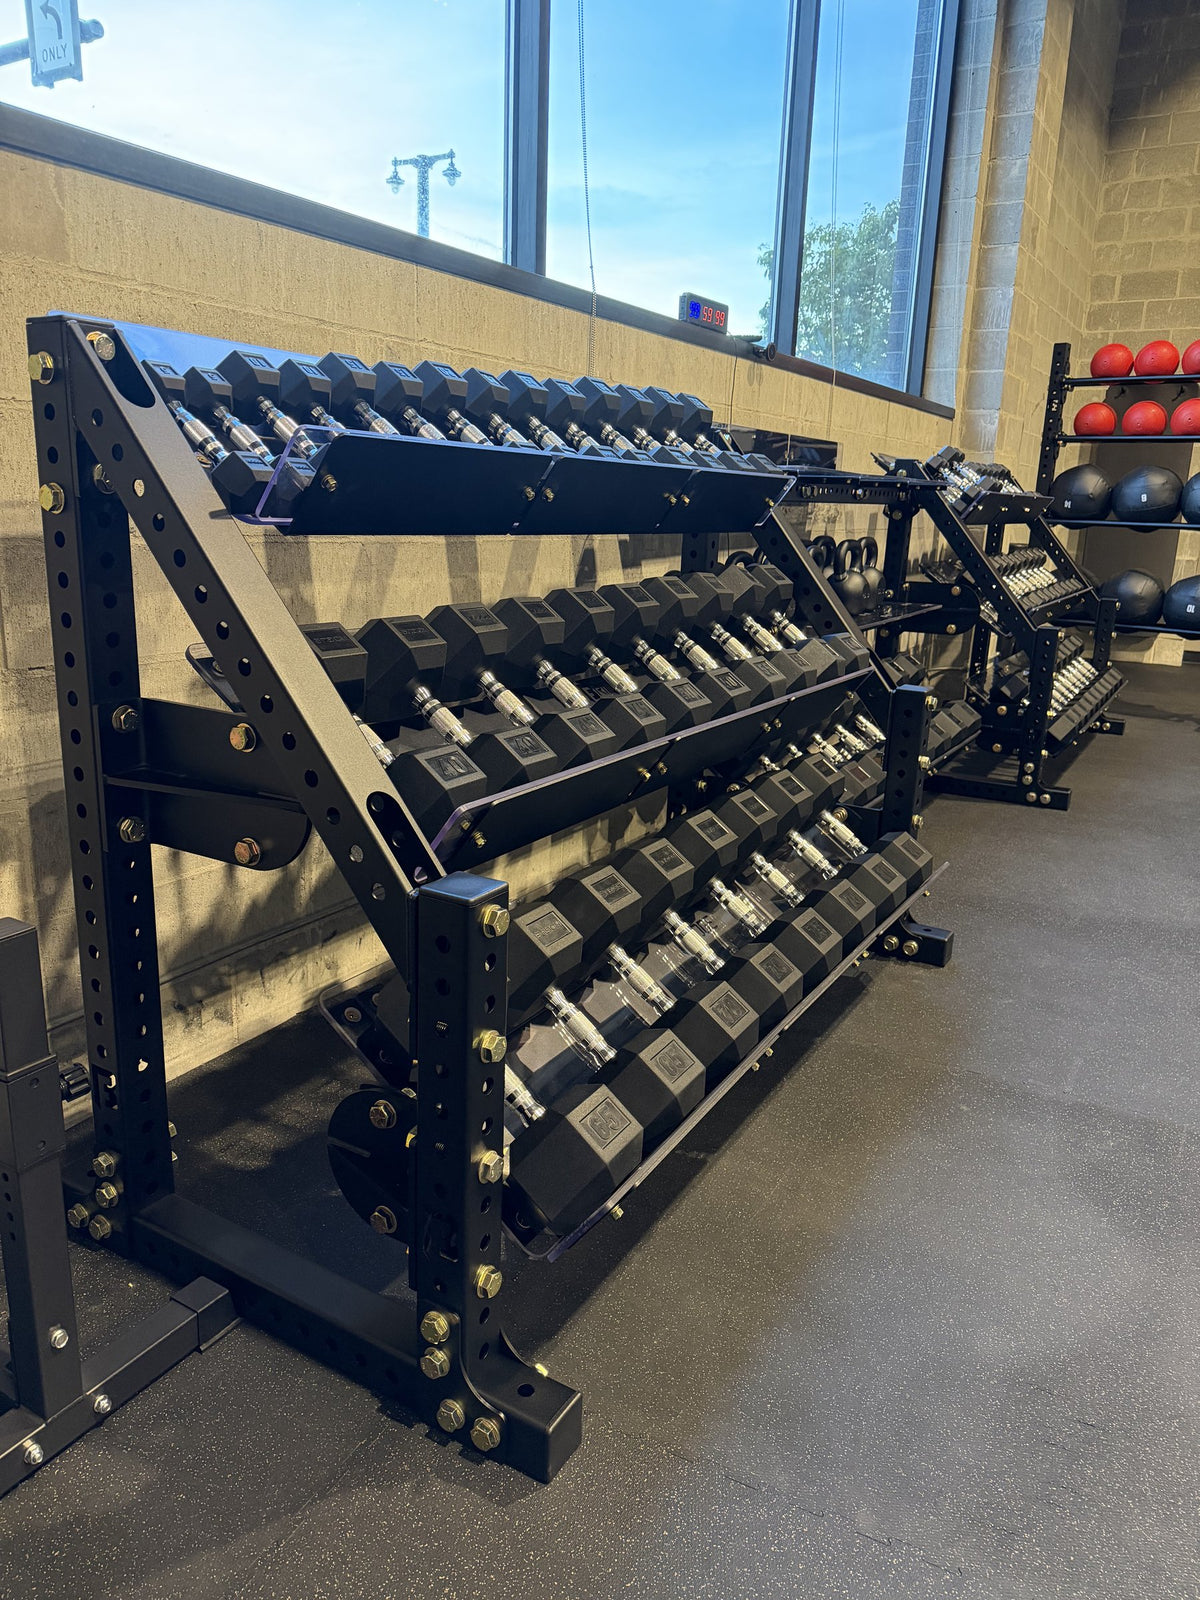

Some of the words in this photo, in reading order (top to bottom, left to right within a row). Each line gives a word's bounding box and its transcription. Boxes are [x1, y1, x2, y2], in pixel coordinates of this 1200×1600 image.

[42, 43, 67, 62] ONLY
[702, 306, 713, 322] 59
[715, 310, 725, 327] 99
[514, 736, 541, 755] 40
[433, 755, 469, 778] 40
[656, 1046, 687, 1078] 65
[587, 1104, 621, 1142] 65
